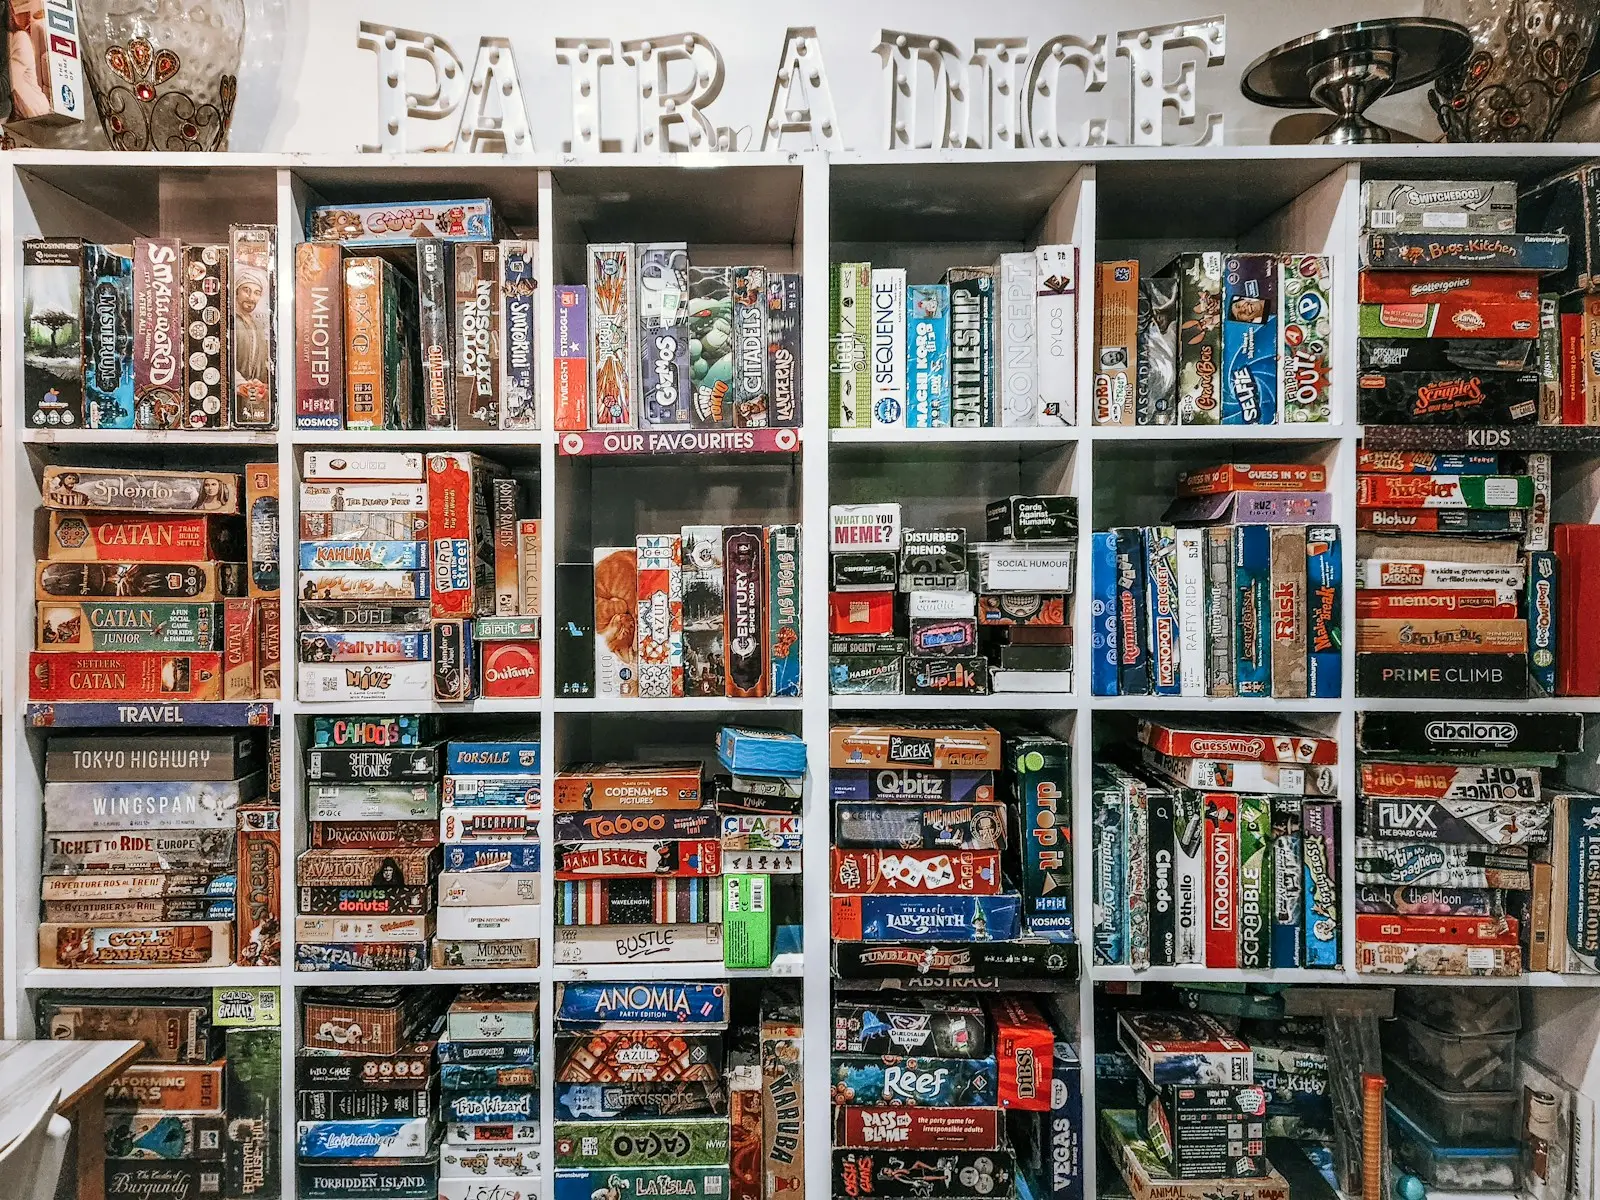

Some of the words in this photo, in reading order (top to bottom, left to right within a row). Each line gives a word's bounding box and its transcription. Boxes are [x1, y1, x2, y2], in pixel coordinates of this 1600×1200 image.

[356, 20, 726, 153] PAIR
[767, 25, 844, 151] A
[871, 14, 1226, 150] DICE
[1407, 187, 1482, 206] SWITCHEROO!
[1428, 242, 1463, 260] Bugs
[1468, 239, 1517, 256] Kitchen
[1524, 235, 1567, 244] Ravensburger
[1411, 278, 1471, 296] Scattergories
[100, 294, 116, 381] MYSTERIUM
[311, 287, 330, 386] IMHOTEP
[463, 301, 476, 377] POTION
[476, 280, 492, 397] EXPLOSION
[876, 283, 893, 384] SEQUENCE
[1007, 265, 1032, 418] CONCEPT
[1050, 308, 1065, 357] PYLOS
[743, 308, 761, 393] CITADELS
[916, 322, 928, 369] KORO
[953, 289, 981, 428] BATTLESHIP
[428, 345, 445, 416] PANDEMIC
[561, 360, 569, 407] TWILIGHT
[776, 349, 793, 420] LANTERNS
[1138, 350, 1149, 425] CASCADIA
[916, 372, 928, 428] MACHI
[1097, 378, 1109, 419] WORD
[298, 418, 338, 427] KOSMOS
[604, 435, 643, 451] OUR
[649, 432, 754, 450] FAVOURITES
[1467, 430, 1511, 446] KIDS
[1248, 471, 1279, 480] GUESS
[1281, 471, 1291, 479] IN
[1294, 471, 1306, 479] 10
[1536, 456, 1550, 491] game
[94, 478, 177, 503] Splendor
[415, 495, 423, 505] 2
[1019, 511, 1049, 519] Against
[1534, 493, 1544, 523] MAD
[834, 515, 860, 525] WHAT
[862, 515, 874, 525] DO
[875, 514, 893, 524] YOU
[1019, 517, 1056, 526] Humanity
[98, 523, 173, 545] CATAN
[260, 515, 272, 572] Splendor
[834, 526, 893, 544] MEME?
[905, 533, 959, 542] DISTURBED
[1532, 525, 1542, 546] The
[317, 546, 372, 561] KAHUNA
[905, 545, 947, 555] FRIENDS
[436, 540, 450, 591] WORD
[80, 564, 90, 595] Splendor
[1383, 574, 1423, 585] PARENTS
[1158, 567, 1168, 615] CRICKET
[1185, 578, 1196, 609] RIDE
[1275, 582, 1294, 642] Risk
[1388, 595, 1456, 610] memory
[90, 608, 153, 627] CATAN
[343, 608, 391, 625] DUEL
[654, 600, 665, 636] AZUL
[101, 633, 140, 644] JUNIOR
[229, 623, 241, 663] CATAN
[267, 625, 279, 659] CATAN
[1185, 616, 1197, 651] RAFTY
[440, 636, 448, 673] Splendor
[832, 644, 847, 653] HIGH
[850, 644, 876, 653] SOCIETY
[1160, 619, 1173, 686] MONOPOLY
[77, 659, 121, 668] SETTLERS
[69, 673, 126, 689] CATAN
[485, 666, 536, 682] Onitama
[1383, 669, 1440, 681] PRIME
[1445, 668, 1502, 682] CLIMB
[118, 706, 183, 722] TRAVEL
[334, 719, 399, 746] CAHOOTS
[457, 751, 479, 763] FOR
[480, 751, 510, 763] SALE
[891, 744, 932, 758] EUREKA
[1193, 742, 1230, 752] Guess
[1230, 741, 1263, 755] Who?
[73, 750, 124, 768] TOKYO
[131, 750, 210, 767] HIGHWAY
[349, 753, 392, 766] SHIFTING
[351, 765, 389, 777] STONES
[605, 787, 668, 796] CODENAMES
[93, 796, 196, 816] WINGSPAN
[1379, 803, 1437, 828] FLUXX
[327, 827, 395, 842] DRAGONWOOD
[584, 814, 665, 838] Taboo
[724, 817, 799, 833] CLACK!
[1392, 829, 1415, 837] BOARD
[1416, 829, 1437, 837] GAME
[50, 839, 102, 854] TICKET
[105, 841, 117, 850] TO
[120, 836, 154, 851] RIDE
[157, 840, 196, 850] EUROPE
[1391, 851, 1442, 881] Spaghetti
[1156, 850, 1171, 912] Cluedo
[1214, 837, 1230, 927] MONOPOLY
[1181, 875, 1192, 928] Othello
[1409, 890, 1427, 903] the
[1432, 890, 1461, 904] Moon
[887, 913, 965, 927] LABYRINTH
[1032, 918, 1070, 926] KOSMOS
[1245, 868, 1261, 966] SCRABBLE
[1381, 925, 1401, 934] GO
[478, 944, 523, 957] MUNCHKIN
[617, 930, 674, 955] BUSTLE
[96, 947, 196, 961] EXPRESS
[595, 986, 691, 1014] ANOMIA
[623, 1051, 653, 1060] AZUL
[885, 1066, 948, 1098] Reef
[454, 1099, 482, 1116] True
[484, 1096, 530, 1116] Wizard
[769, 1072, 800, 1164] KARUBA
[930, 1117, 946, 1126] party
[948, 1117, 963, 1126] game
[965, 1116, 975, 1125] for
[862, 1127, 908, 1142] BLAME
[923, 1125, 963, 1134] irresponsible
[614, 1132, 691, 1157] CACAO
[1054, 1118, 1071, 1191] VEGAS
[110, 1172, 190, 1194] Burgundy
[314, 1177, 377, 1188] FORBIDDEN
[381, 1176, 424, 1187] ISLAND
